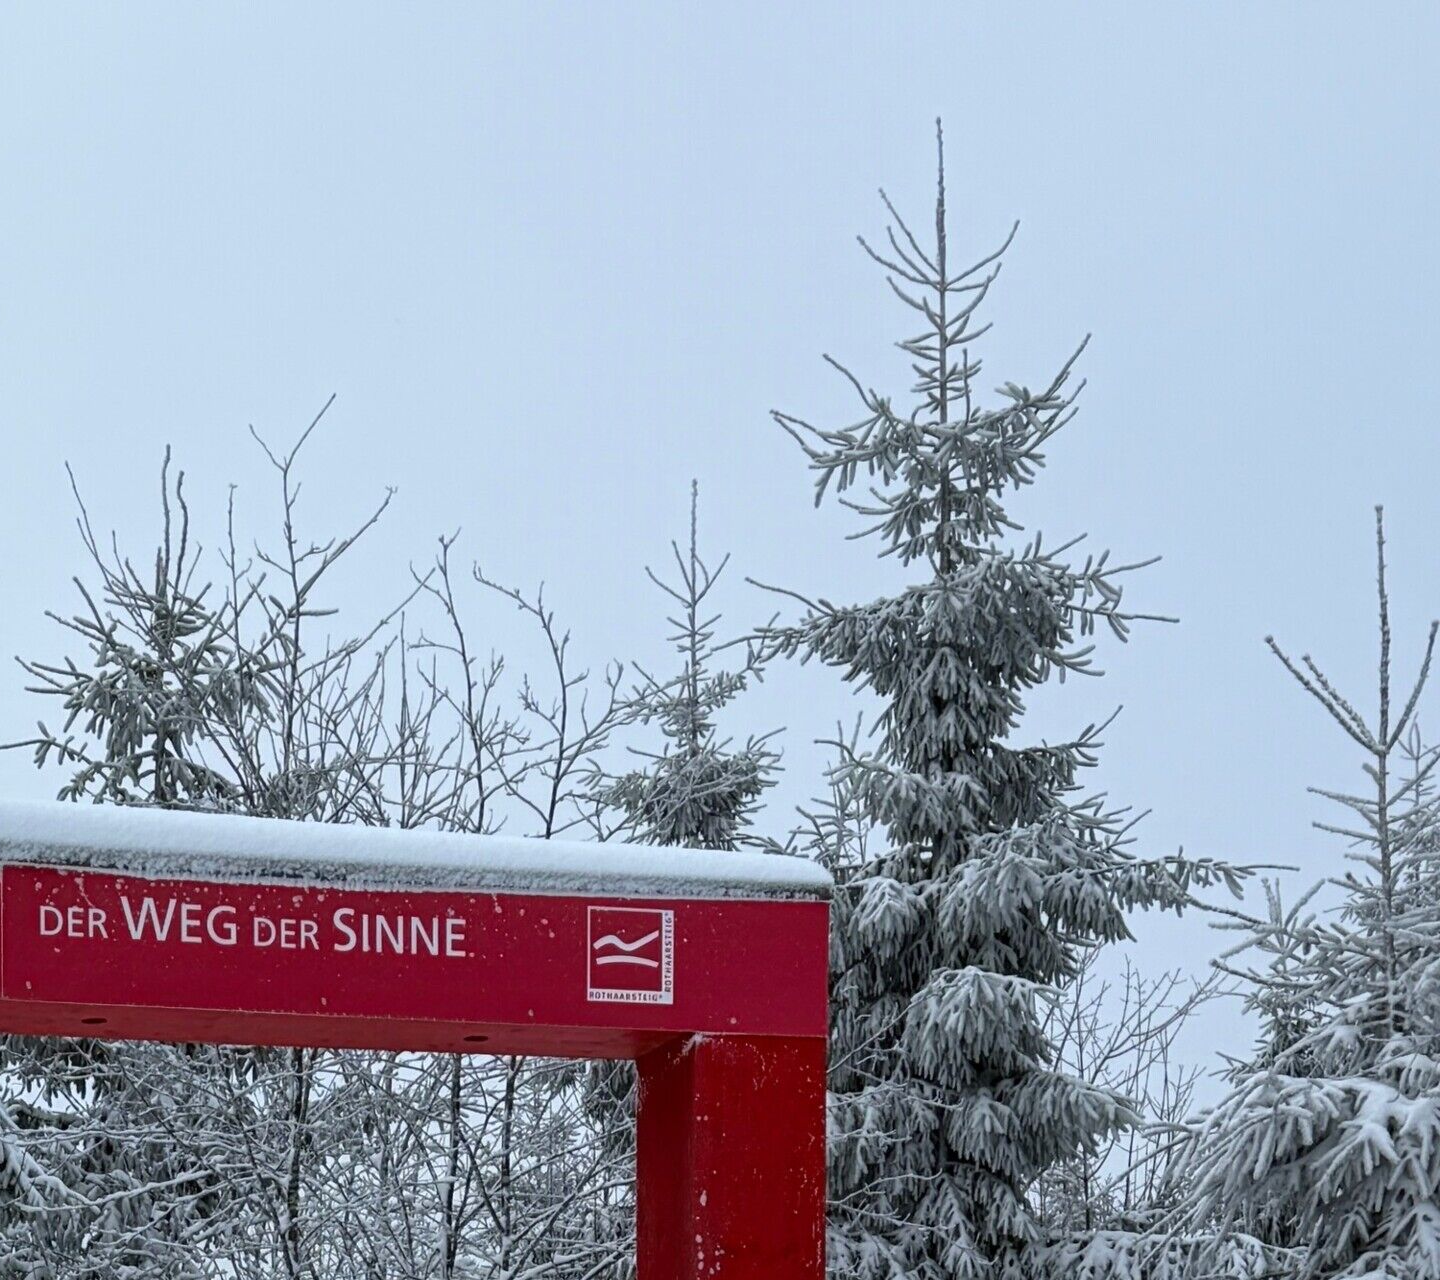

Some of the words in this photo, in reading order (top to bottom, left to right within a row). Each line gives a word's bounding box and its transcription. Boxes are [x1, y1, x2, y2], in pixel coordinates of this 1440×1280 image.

[39, 904, 107, 939] DER
[120, 895, 238, 948] WEG
[252, 916, 320, 951] DER
[333, 906, 467, 958] SINNE
